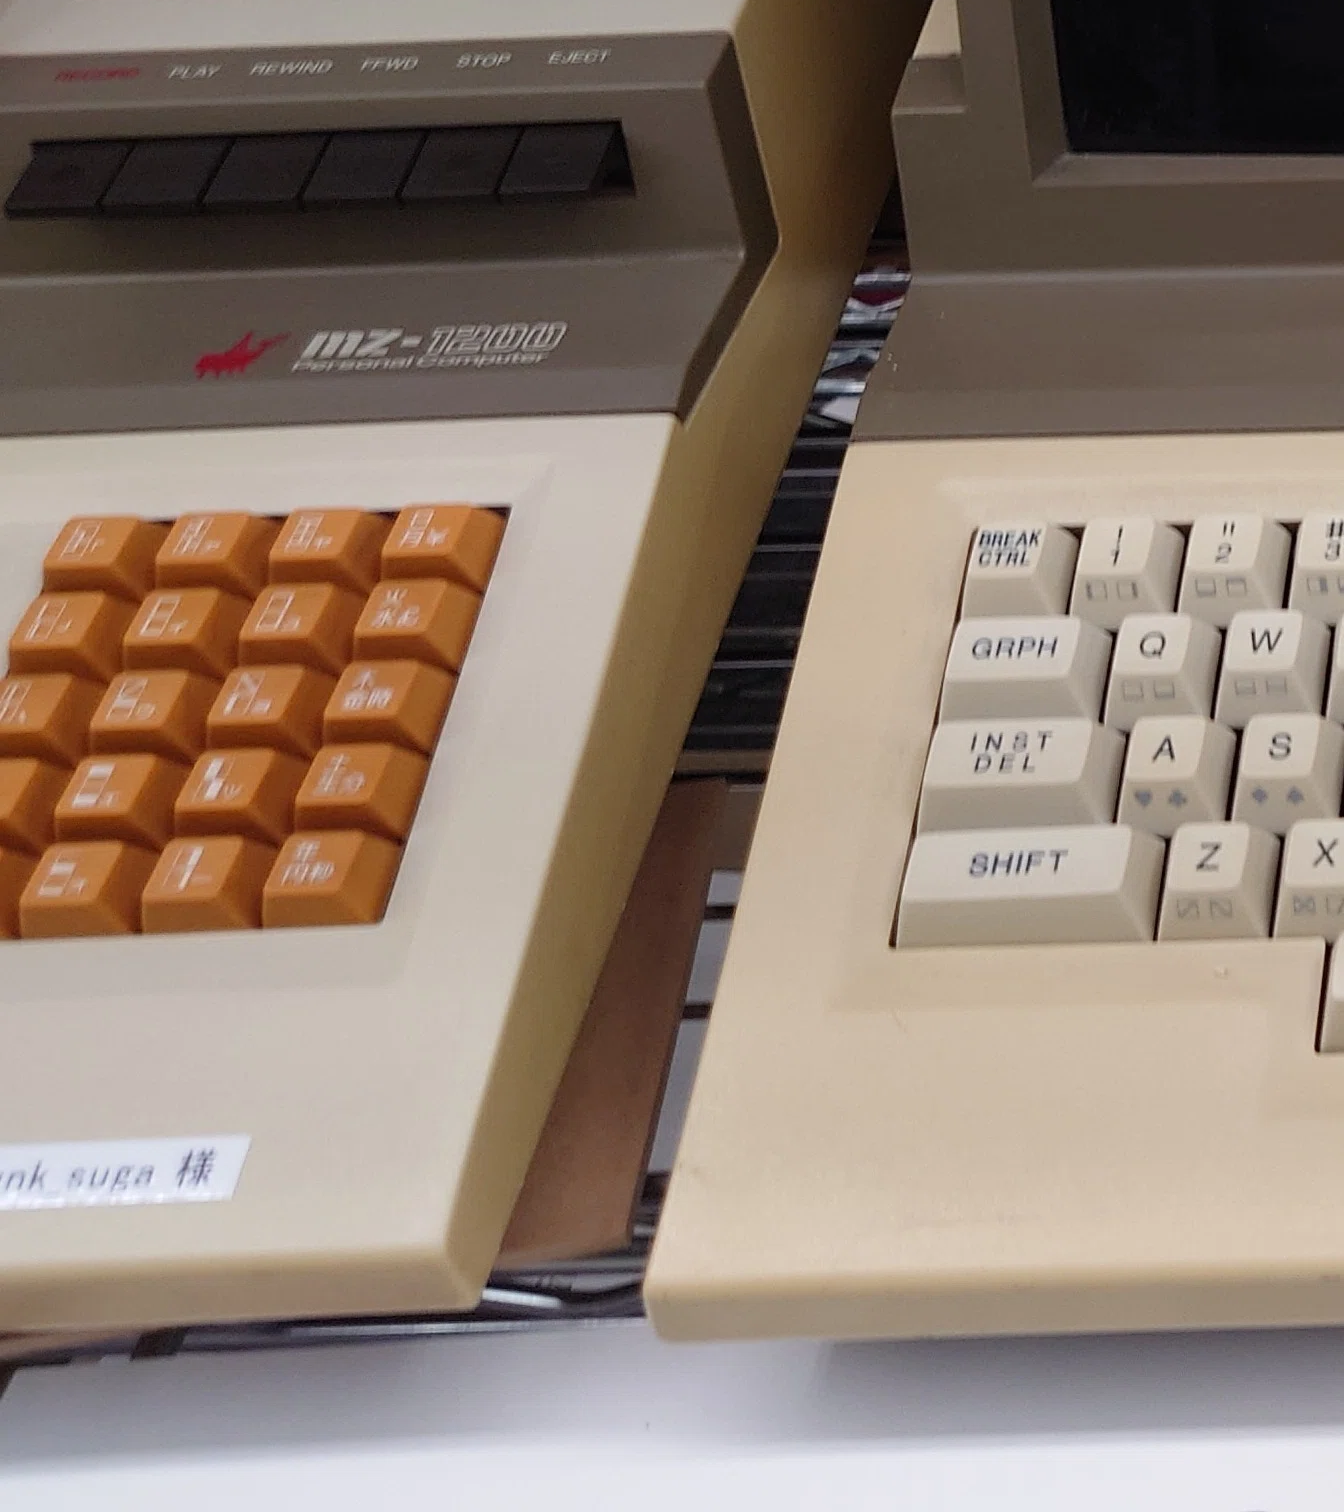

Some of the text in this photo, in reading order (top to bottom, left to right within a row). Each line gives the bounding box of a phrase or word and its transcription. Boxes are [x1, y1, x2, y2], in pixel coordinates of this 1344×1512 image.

[249, 59, 334, 76] REWIND
[455, 51, 512, 68] STOP
[548, 49, 611, 65] EJECT
[168, 63, 222, 80] PLAY
[291, 350, 549, 374] Personal Computer
[979, 530, 1041, 547] BREAK
[979, 550, 1030, 566] CTRL
[1215, 543, 1232, 563] 2
[1325, 542, 1340, 559] 3
[972, 637, 1057, 658] GRPH
[1140, 633, 1166, 658] Q
[1251, 629, 1282, 652] W
[971, 732, 1054, 753] INST
[1153, 737, 1175, 762] A
[1269, 734, 1291, 759] S
[974, 751, 1038, 772] DEL
[1196, 843, 1222, 871] Z
[1314, 840, 1337, 866] X
[969, 851, 1070, 879] SHIFT
[0, 1146, 217, 1191] nk_suga 様
